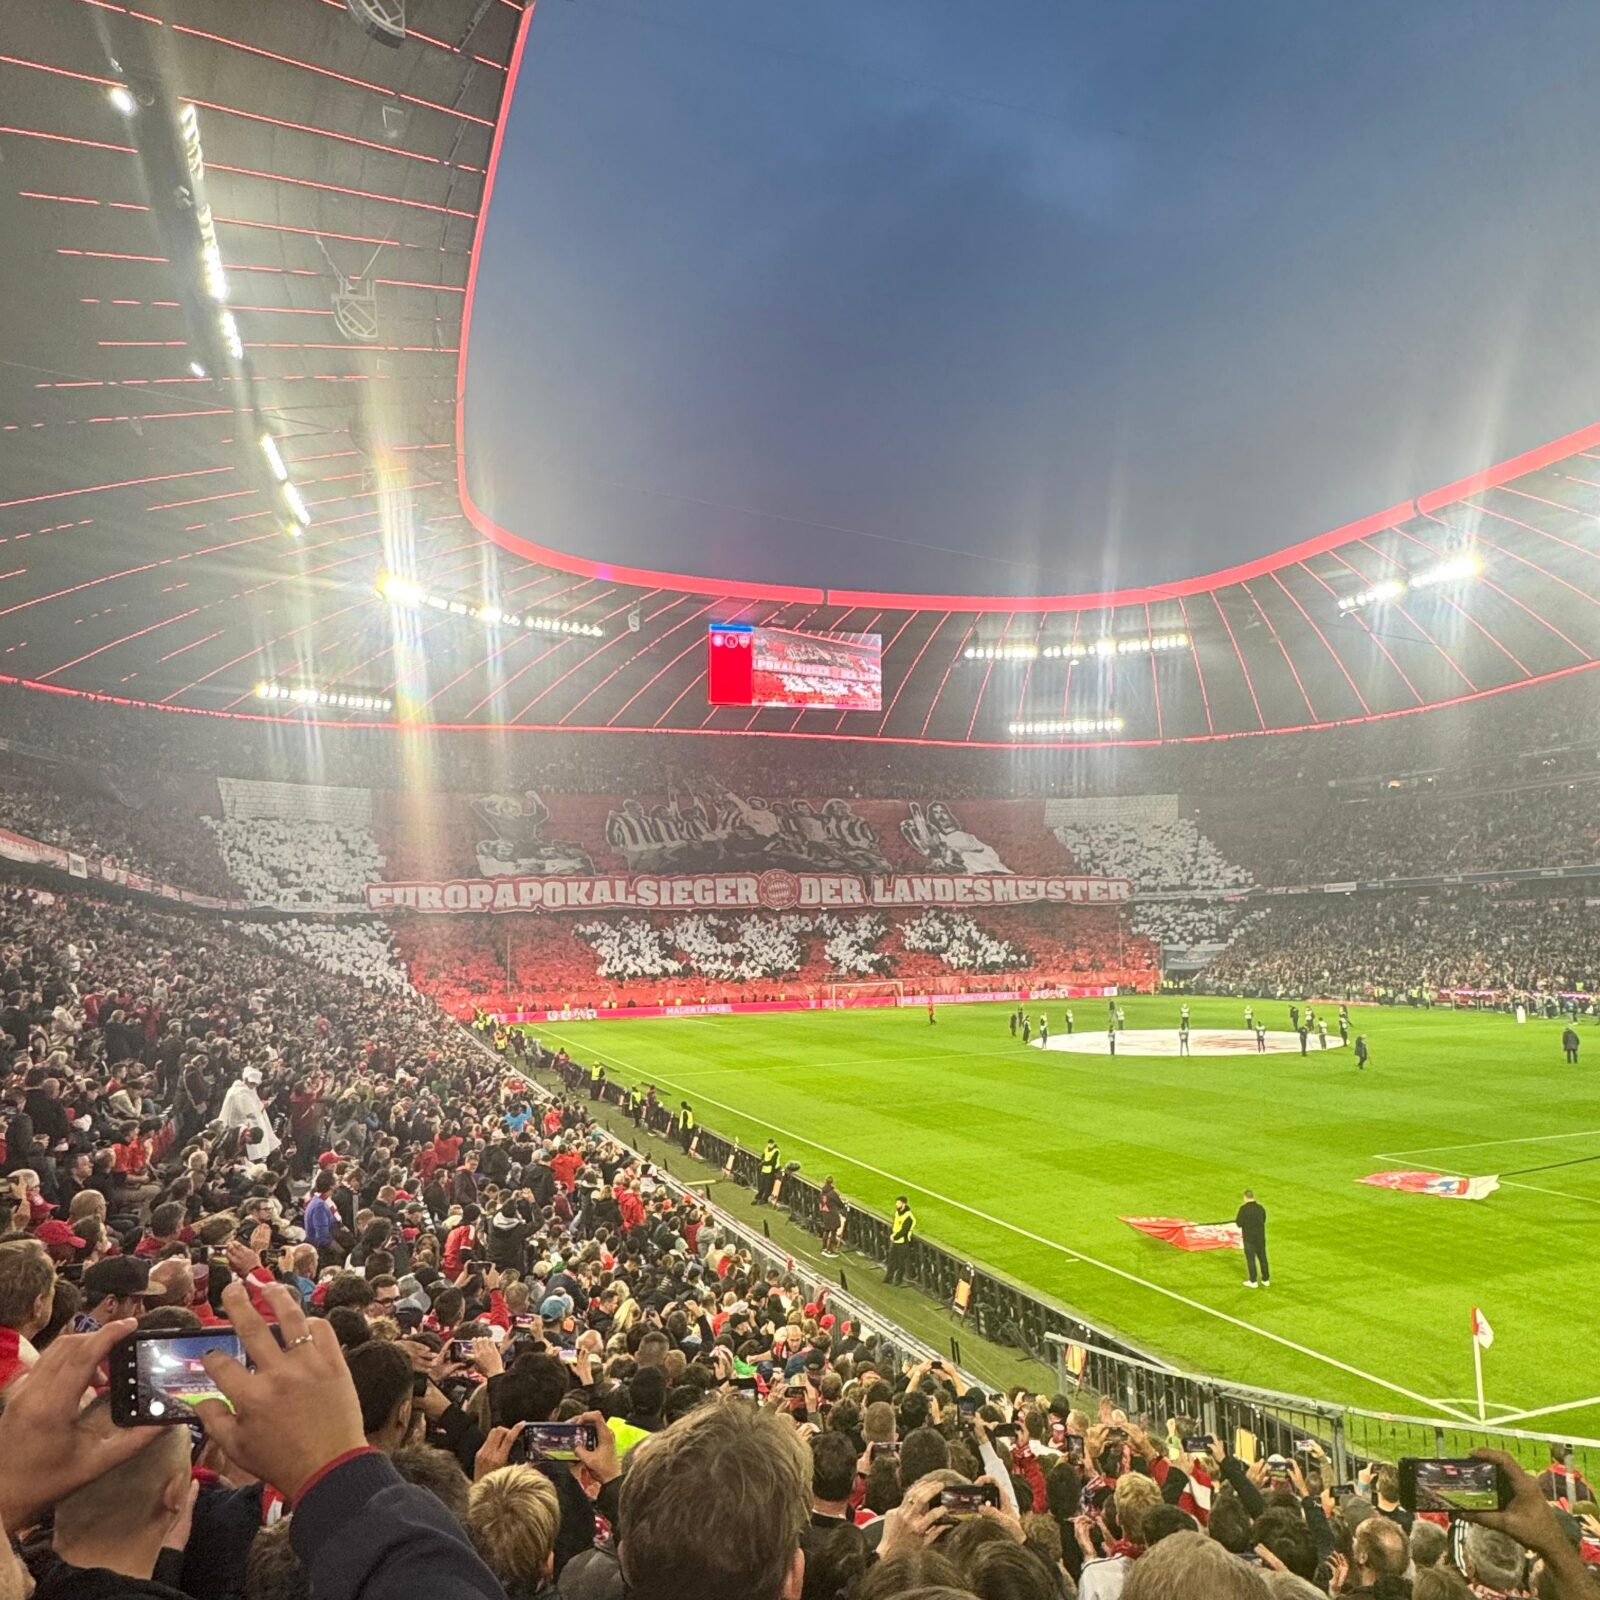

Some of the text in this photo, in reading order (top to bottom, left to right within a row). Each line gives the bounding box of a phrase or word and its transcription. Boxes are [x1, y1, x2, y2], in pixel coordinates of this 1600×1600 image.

[369, 878, 759, 908] EUROPAPOKALSIEGER
[800, 878, 864, 904] DER
[874, 878, 1129, 903] LANDESMEISTER
[666, 1006, 707, 1015] MAGENTA
